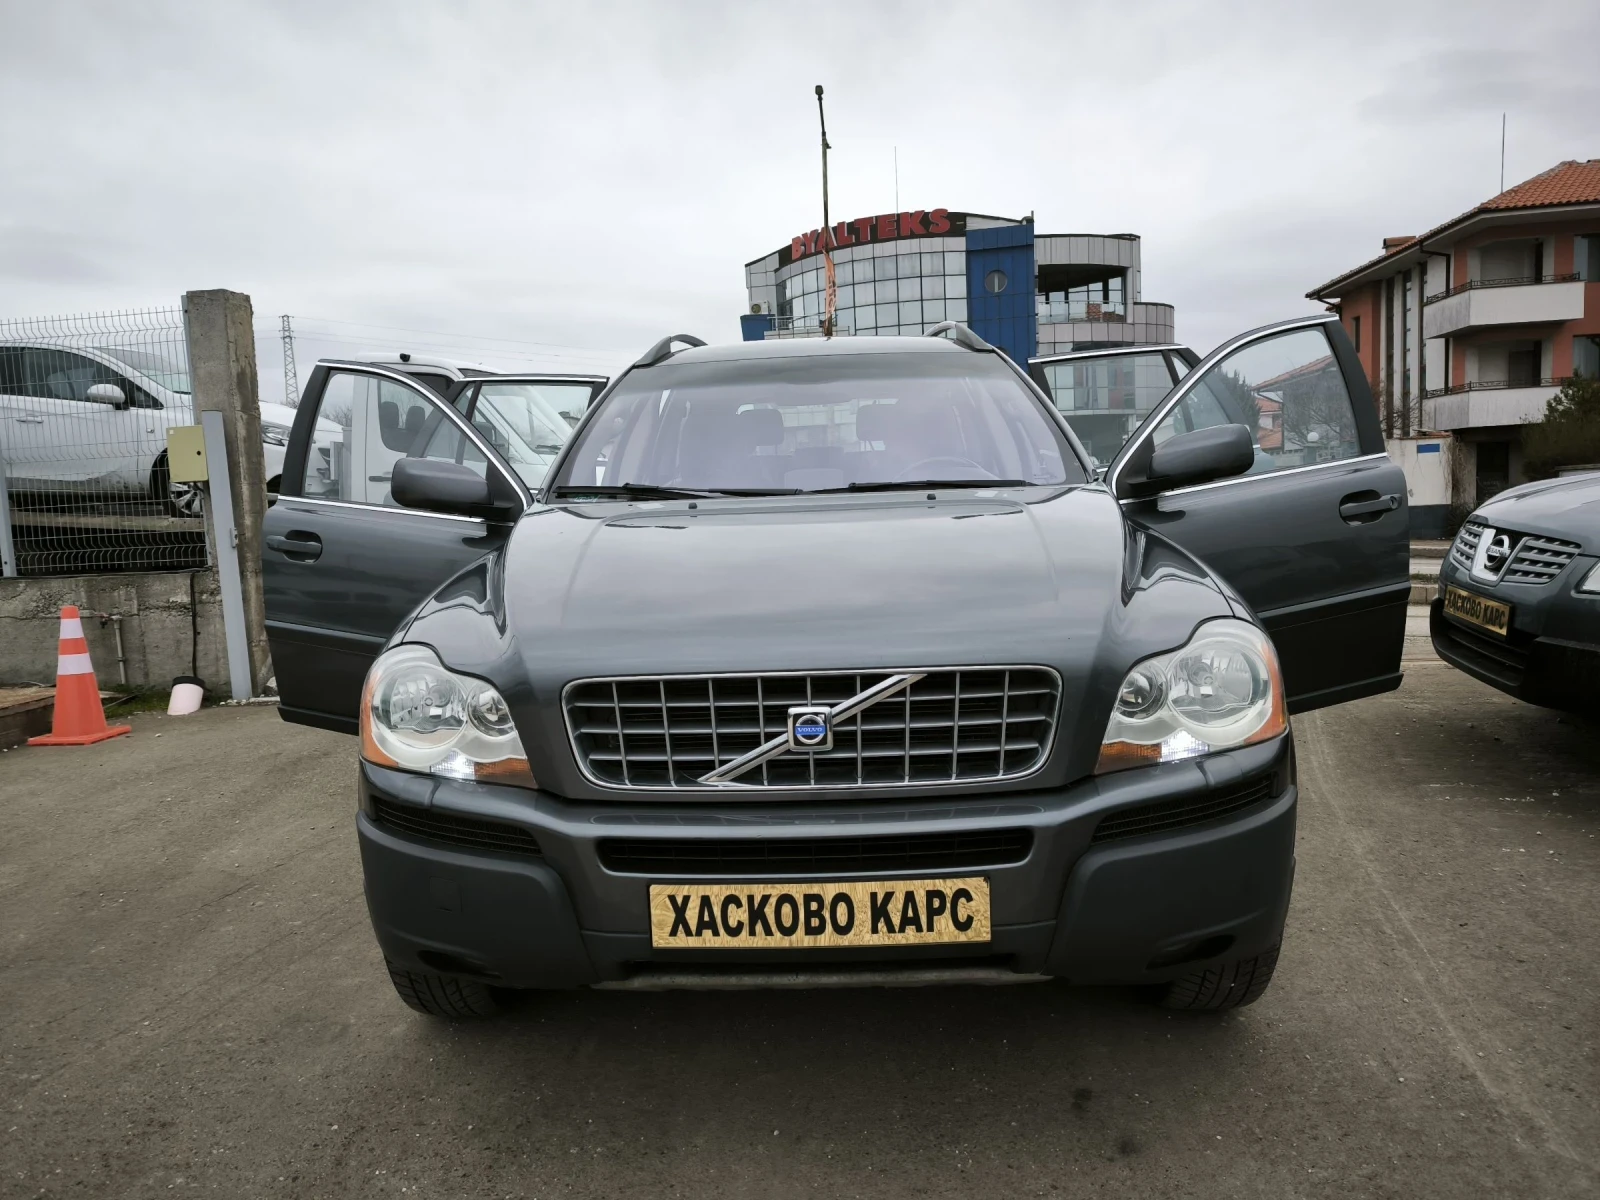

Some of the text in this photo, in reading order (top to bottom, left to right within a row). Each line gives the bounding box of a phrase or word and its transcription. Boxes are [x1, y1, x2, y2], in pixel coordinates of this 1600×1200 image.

[791, 208, 951, 260] BYALTEKS
[1446, 589, 1506, 630] ХАСКОВО КАРС
[667, 888, 975, 938] ХАСКОВО КАРС
